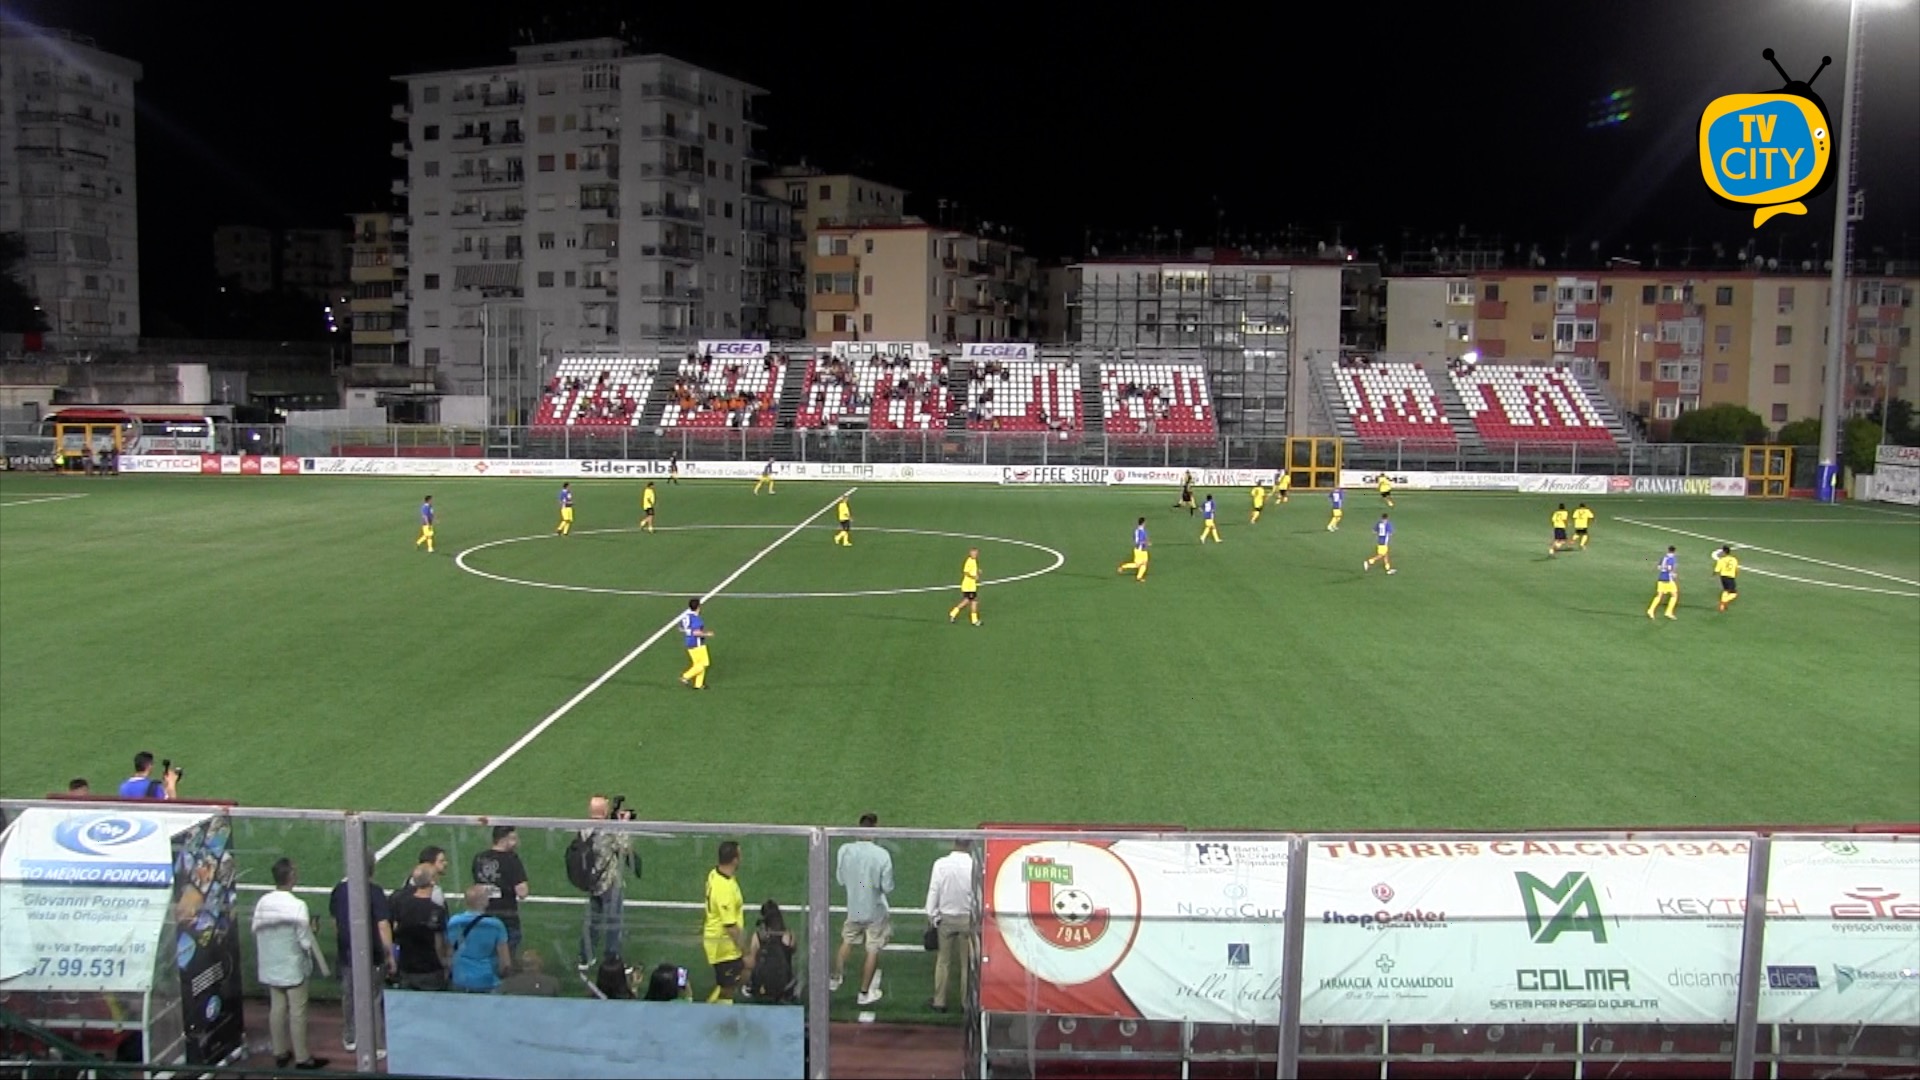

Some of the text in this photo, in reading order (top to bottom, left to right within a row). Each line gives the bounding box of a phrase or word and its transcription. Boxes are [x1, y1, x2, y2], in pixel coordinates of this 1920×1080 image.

[706, 342, 763, 355] LEGEA
[848, 343, 914, 355] COLMA
[969, 344, 1027, 358] LEGEA
[136, 460, 200, 469] KEYTECH
[821, 465, 874, 475] COLMA
[1071, 468, 1109, 483] SHOP
[1318, 841, 1470, 858] TURRIS
[1489, 843, 1649, 856] CALCIO
[44, 868, 102, 880] MEDICO
[102, 869, 166, 882] PORPORA
[1028, 866, 1069, 879] TURRIS
[24, 894, 150, 908] Giovanni Porpora
[1322, 909, 1446, 928] ShopCenter
[1056, 926, 1091, 942] 1944
[1320, 976, 1454, 989] FARMACIA AI CAMALDOLI
[1516, 969, 1631, 991] COLMA
[1534, 1000, 1558, 1009] PER
